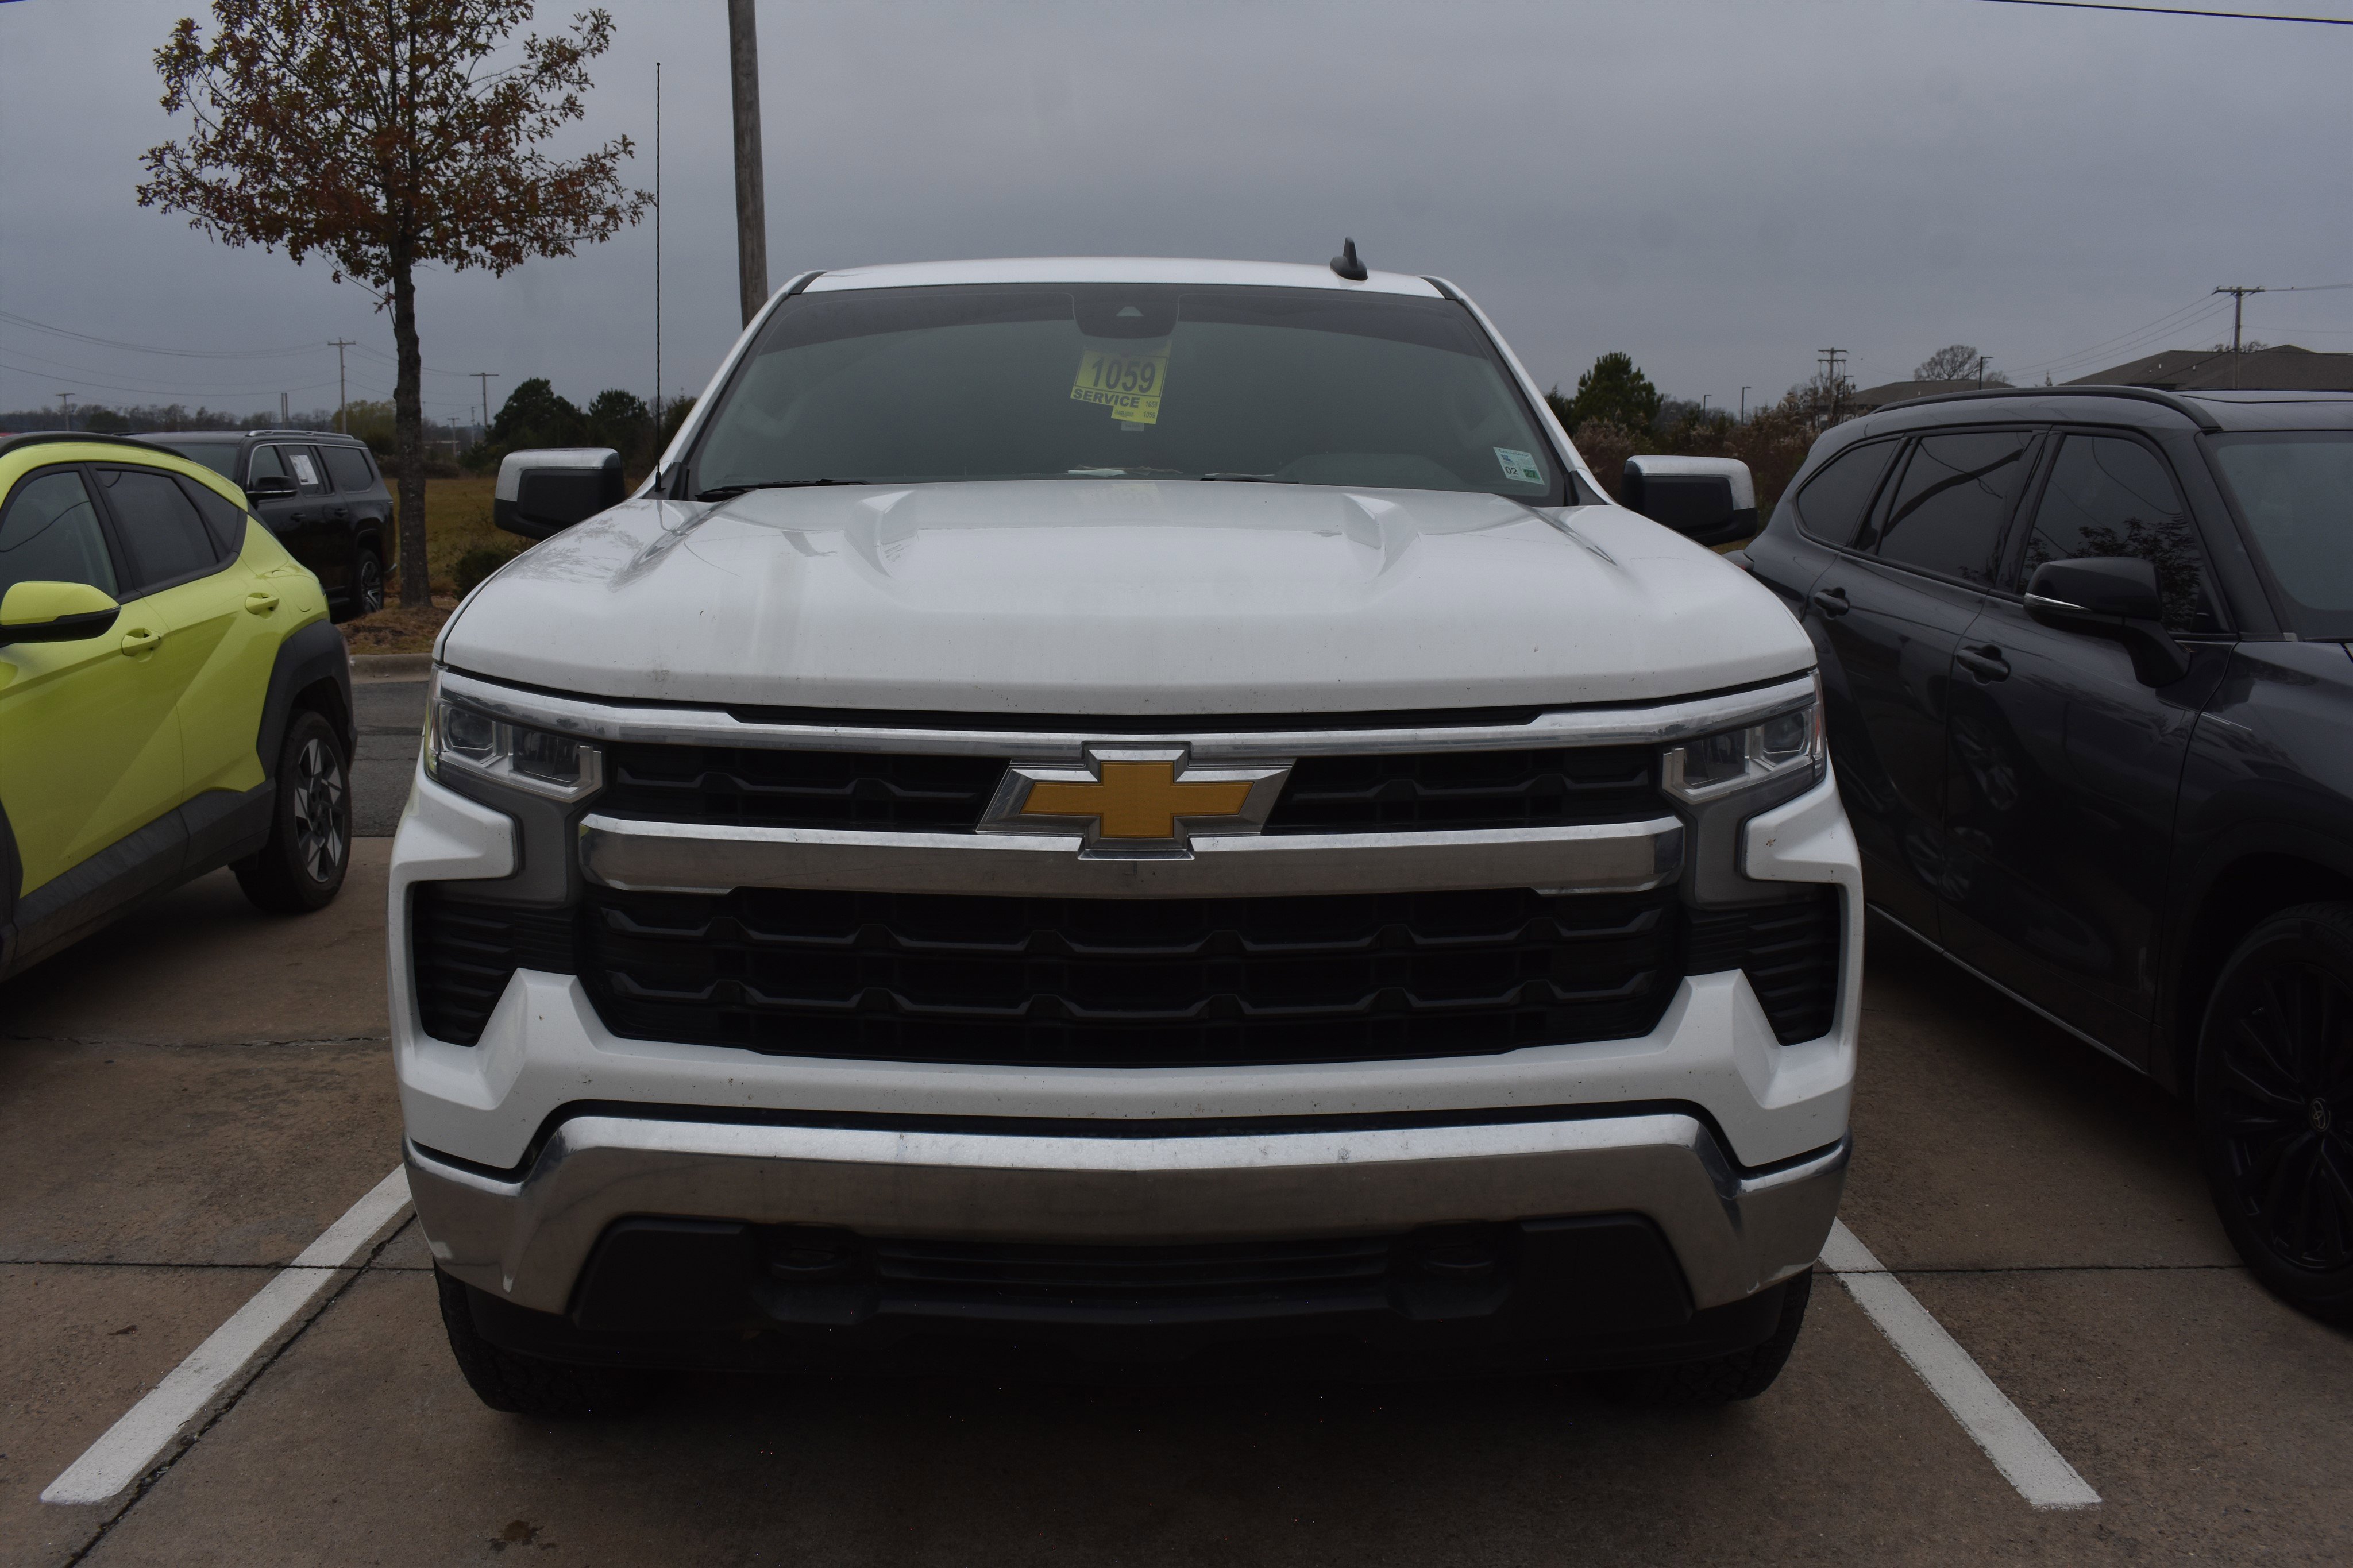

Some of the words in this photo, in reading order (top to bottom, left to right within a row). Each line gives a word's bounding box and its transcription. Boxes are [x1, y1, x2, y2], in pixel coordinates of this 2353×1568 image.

[1091, 357, 1156, 393] 1059
[1073, 389, 1140, 408] SERVICE
[1505, 466, 1519, 475] 02
